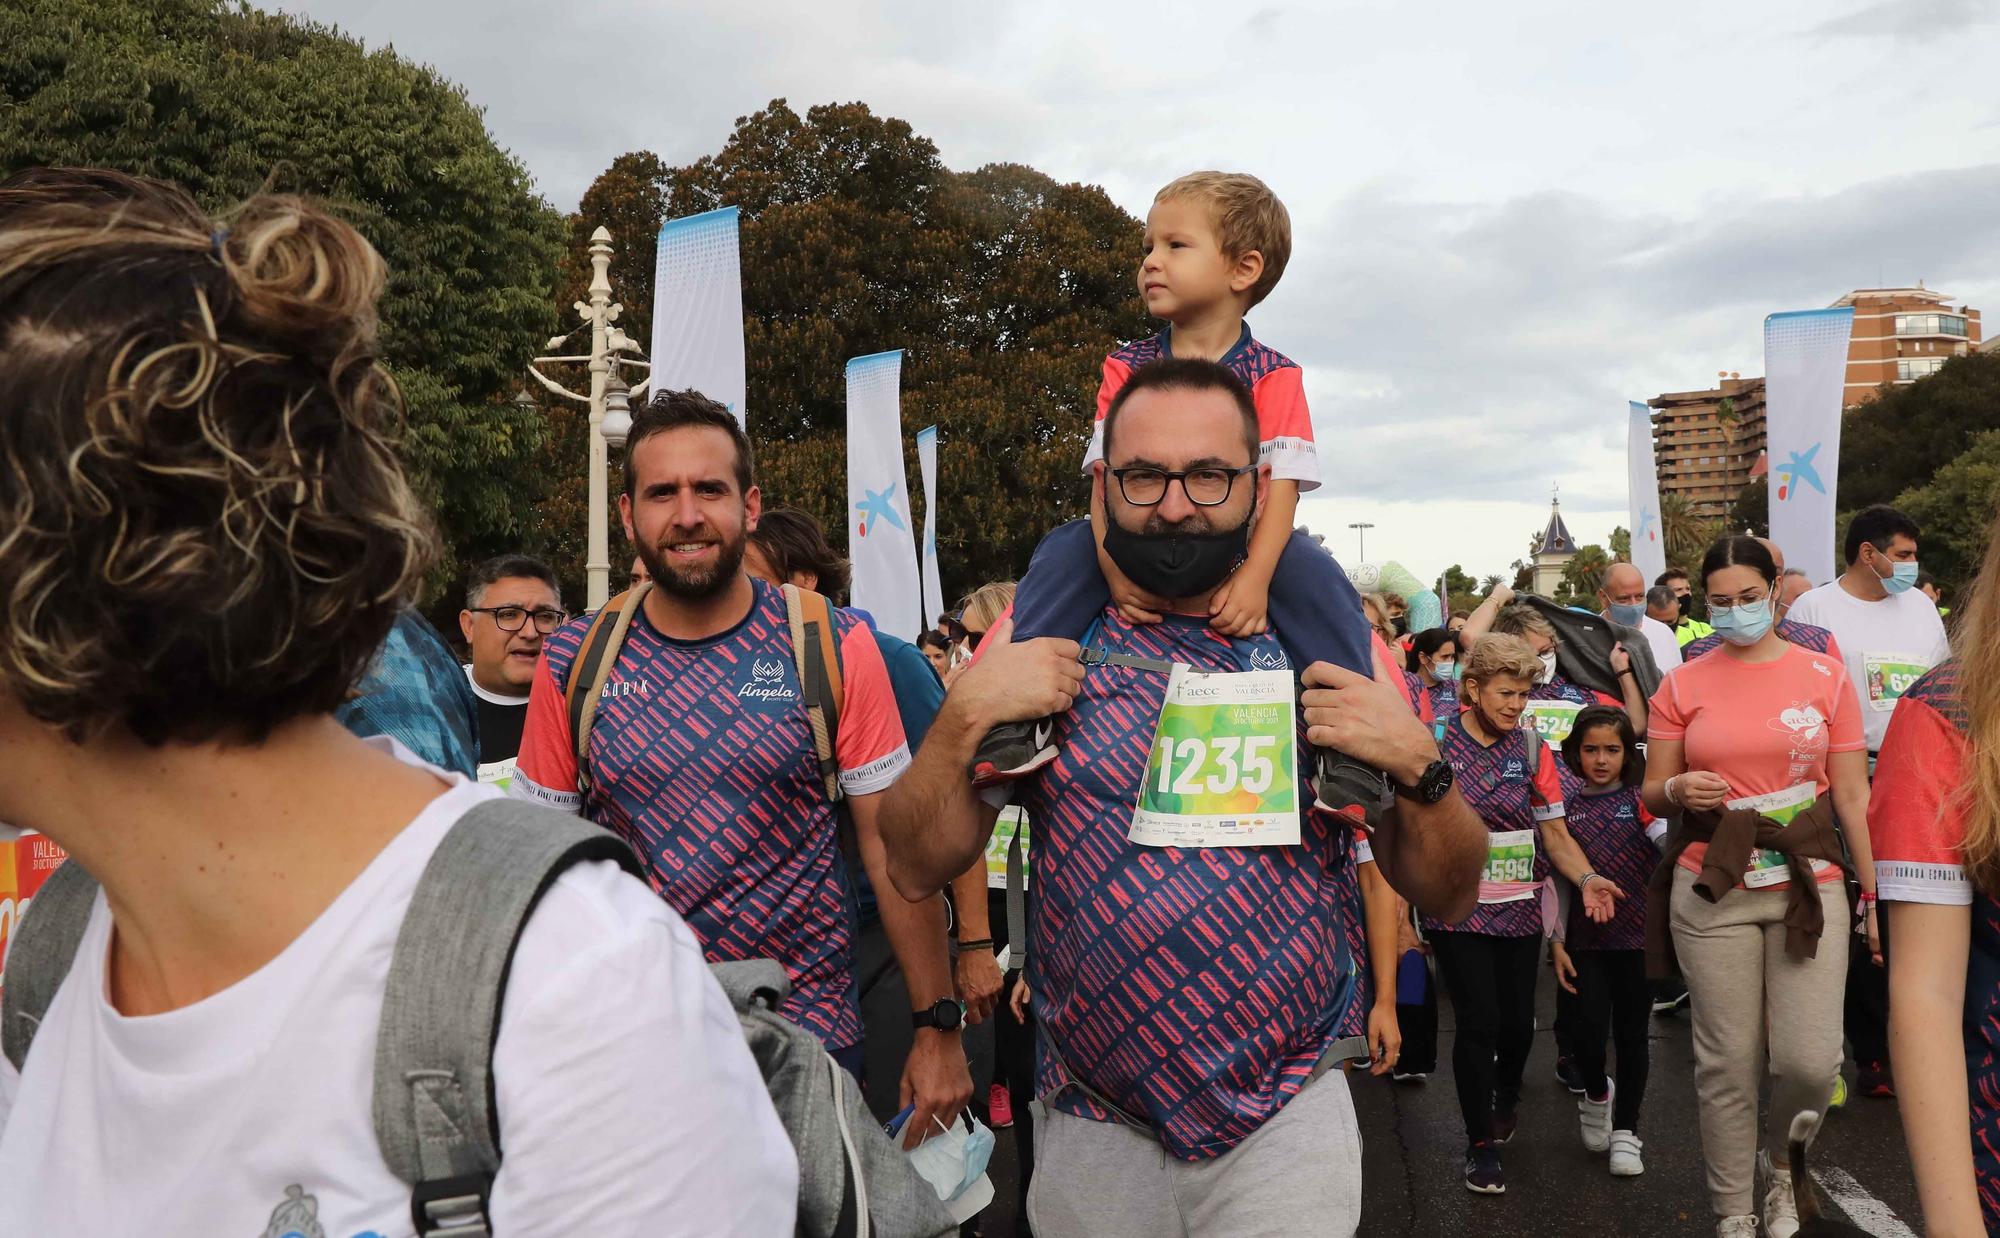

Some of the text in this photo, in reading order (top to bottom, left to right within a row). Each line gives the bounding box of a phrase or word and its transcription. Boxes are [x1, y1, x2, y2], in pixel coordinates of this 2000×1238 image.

[602, 680, 648, 698] GOBIK
[737, 682, 796, 702] Ángela
[1187, 687, 1220, 697] aecc
[1233, 707, 1278, 718] VALENCIA
[1158, 736, 1275, 794] 1235
[1118, 944, 1190, 1012] AMOR
[1180, 854, 1281, 957] INFINITO
[1135, 932, 1271, 1058] GUERRERA
[1141, 1024, 1236, 1111] INFINITO
[1221, 959, 1298, 1040] GOONIE
